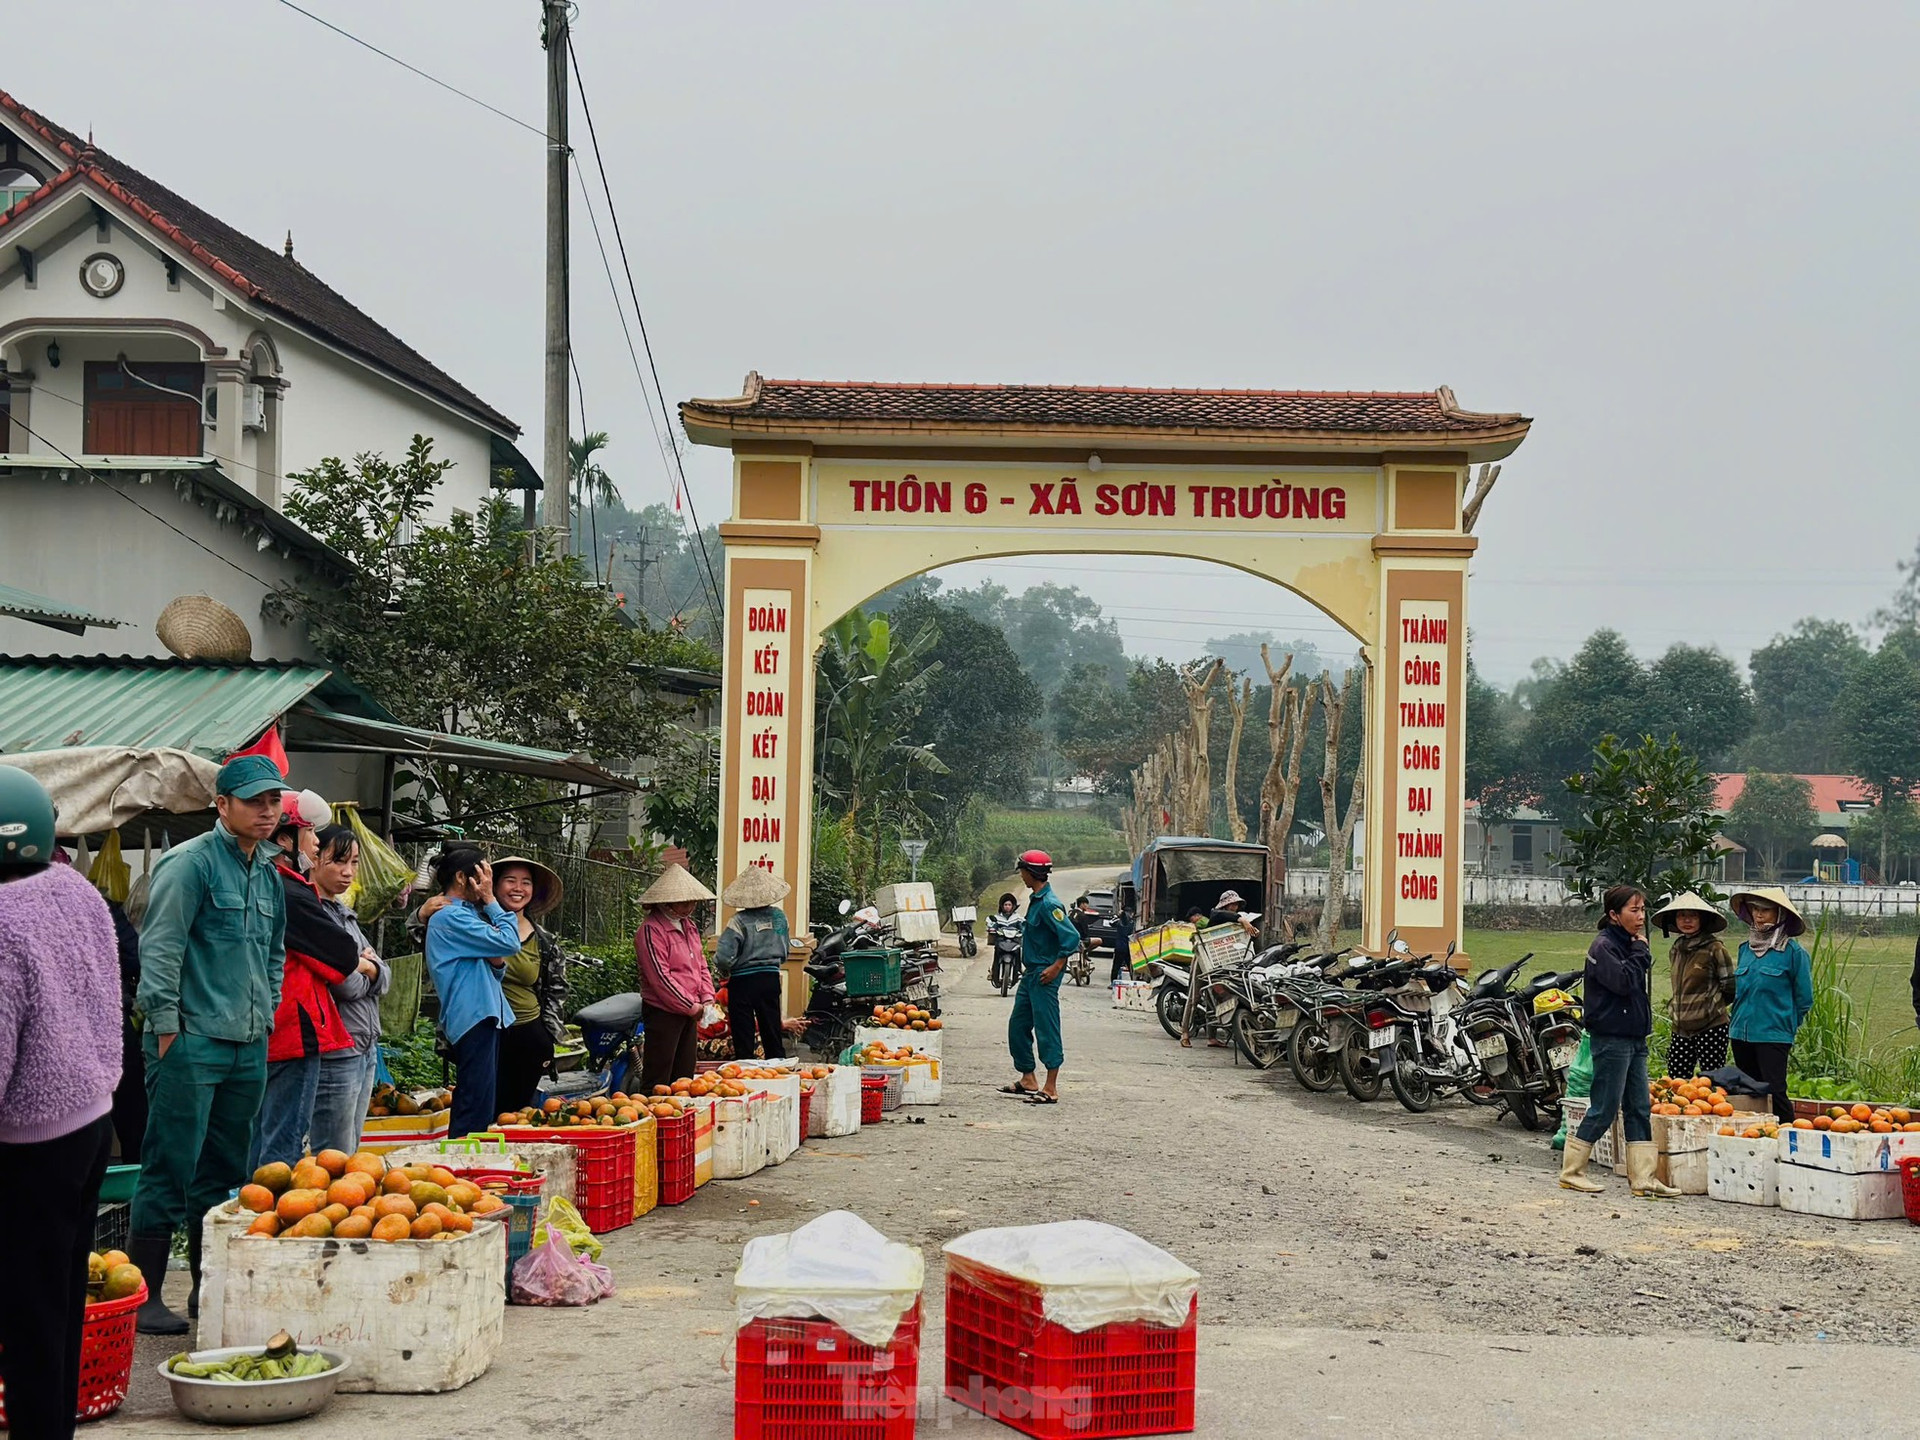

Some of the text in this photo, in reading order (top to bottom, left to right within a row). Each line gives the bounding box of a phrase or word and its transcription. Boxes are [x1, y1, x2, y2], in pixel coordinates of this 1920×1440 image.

[849, 474, 952, 513] THÔN
[964, 482, 988, 515] 6
[1028, 477, 1082, 515] XÃ
[1094, 481, 1176, 516] SƠN
[1188, 478, 1346, 519] TRƯỜNG
[749, 602, 786, 632] ĐOÀN
[1402, 614, 1448, 645] THÀNH
[754, 642, 779, 675] KẾT
[1404, 655, 1441, 686] CÔNG
[747, 687, 784, 717] ĐOÀN
[1400, 698, 1445, 728] THÀNH
[752, 726, 778, 759] KẾT
[1403, 740, 1440, 771] CÔNG
[751, 775, 776, 806] ĐẠI
[1408, 787, 1432, 817] ĐẠI
[743, 812, 780, 843] ĐOÀN
[1397, 828, 1443, 859] THÀNH
[1401, 869, 1438, 900] CÔNG
